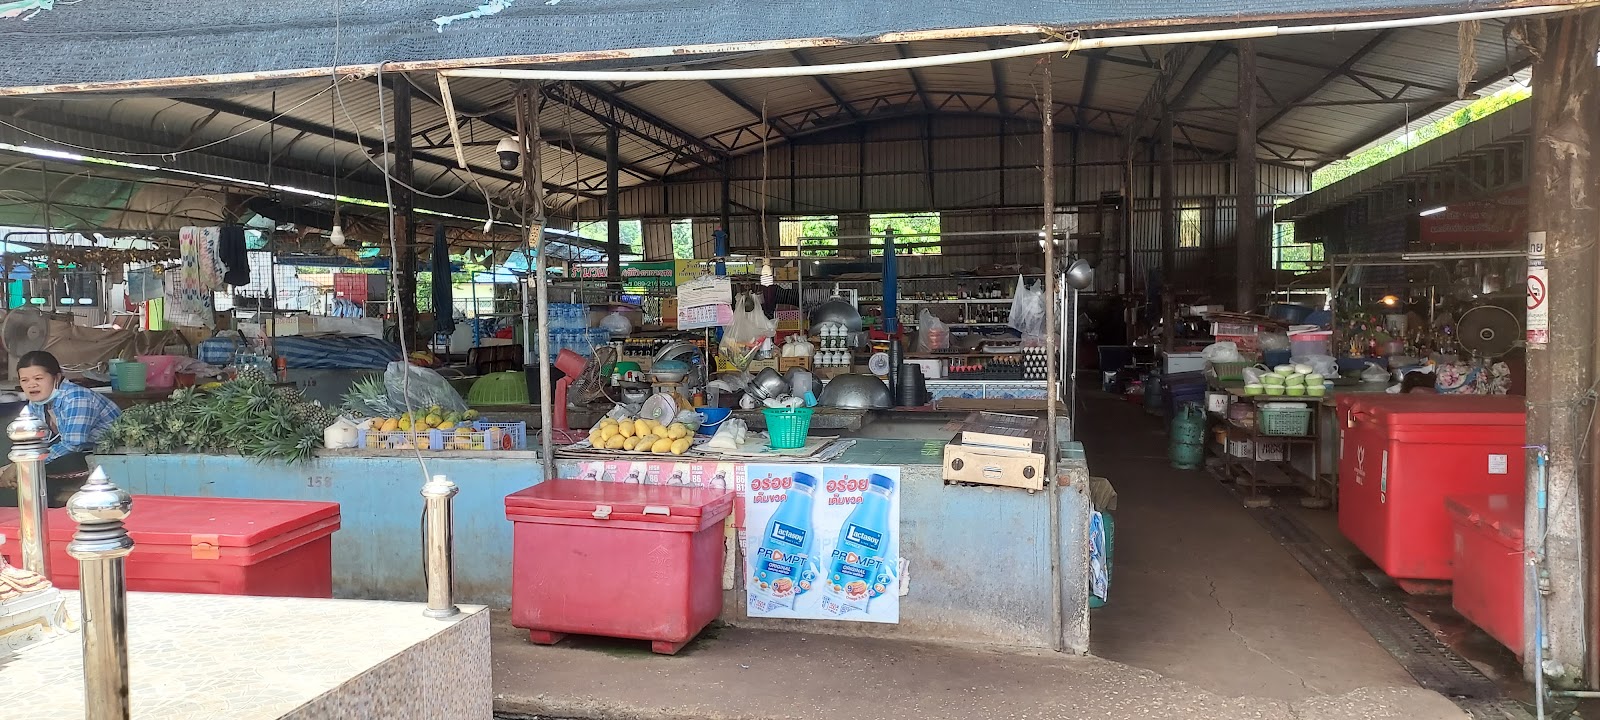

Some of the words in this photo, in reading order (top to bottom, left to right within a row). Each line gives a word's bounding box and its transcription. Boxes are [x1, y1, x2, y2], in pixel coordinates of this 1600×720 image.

[751, 473, 793, 491] อร่อย
[826, 474, 870, 493] อร่อย
[772, 523, 804, 543] Lactasoy
[846, 525, 880, 546] Lactasoy
[757, 547, 808, 566] PROMPT
[831, 549, 883, 569] PROMPT
